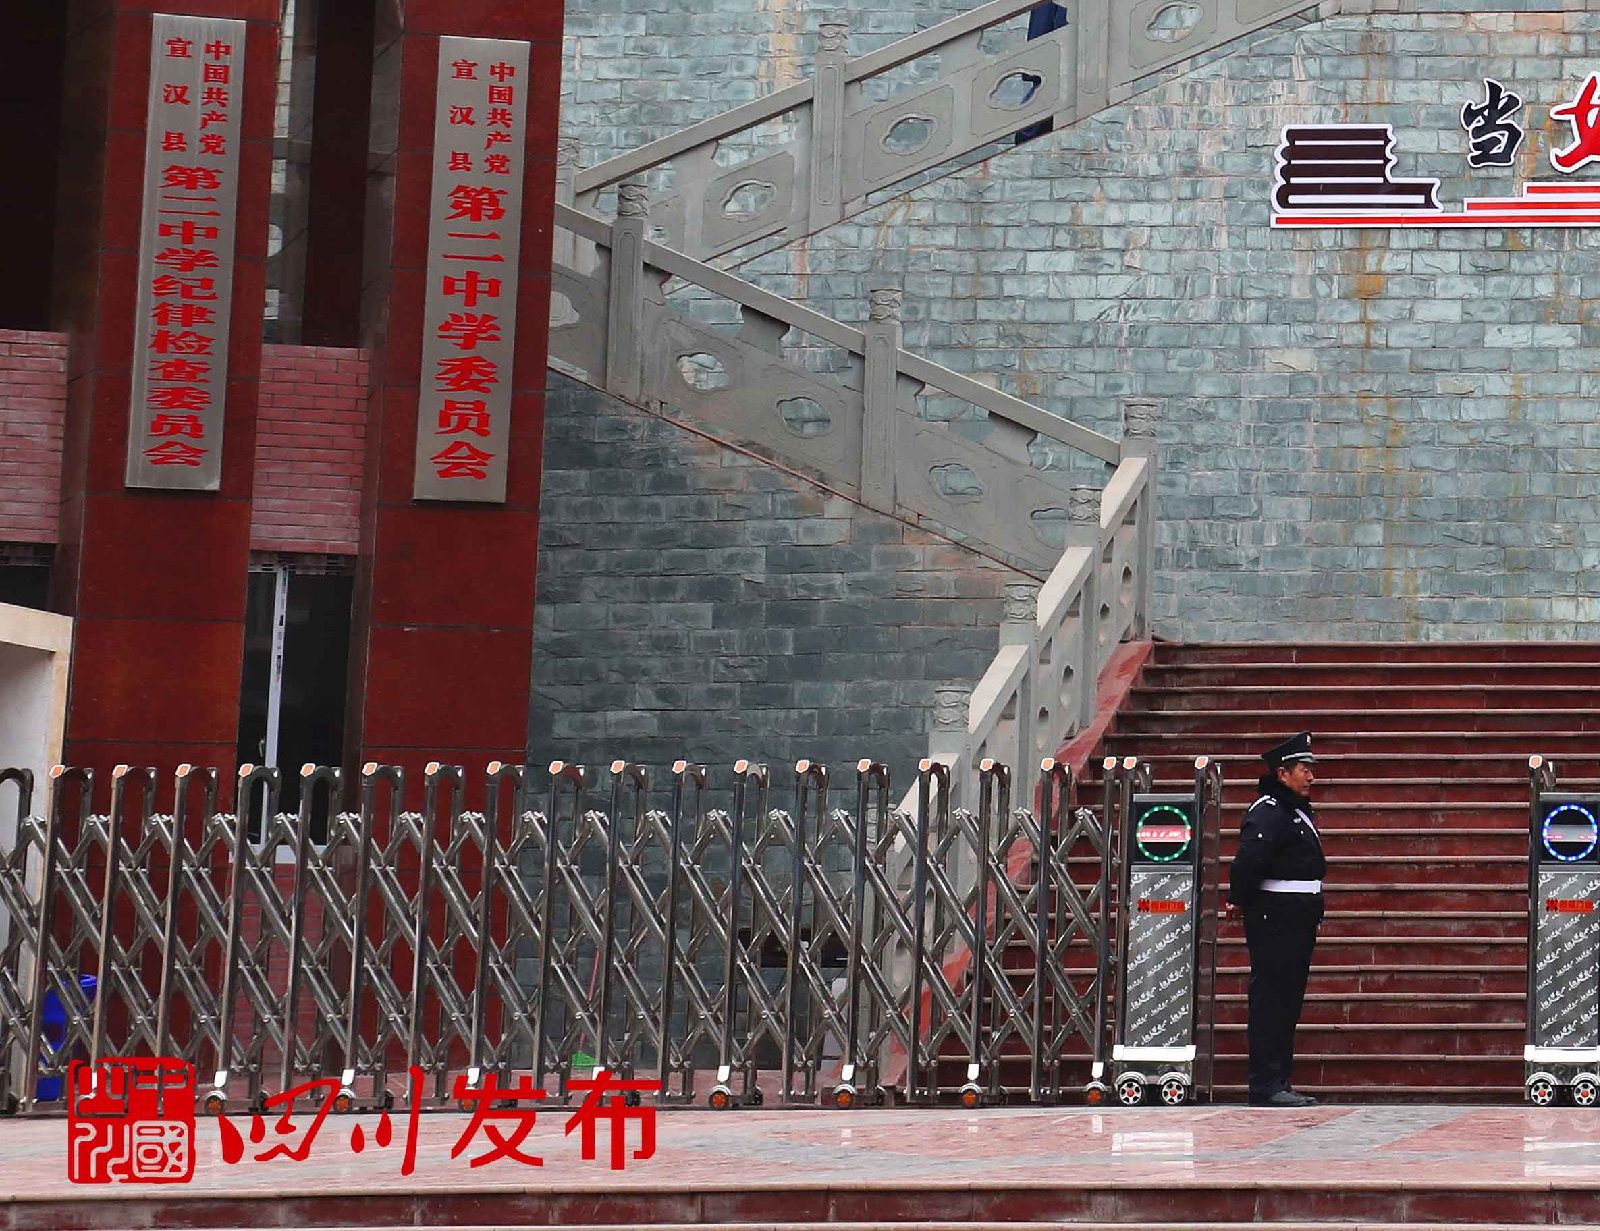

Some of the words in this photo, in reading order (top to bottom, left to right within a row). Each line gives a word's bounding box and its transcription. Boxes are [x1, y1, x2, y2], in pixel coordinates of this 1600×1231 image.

[161, 36, 193, 153] 宣汉县
[199, 39, 232, 156] 中国共产党
[447, 59, 478, 173] 宣汉县
[484, 61, 516, 176] 中国共产党
[144, 163, 222, 468] 第二中学纪律检查委员会
[430, 184, 507, 480] 第二中学委员会
